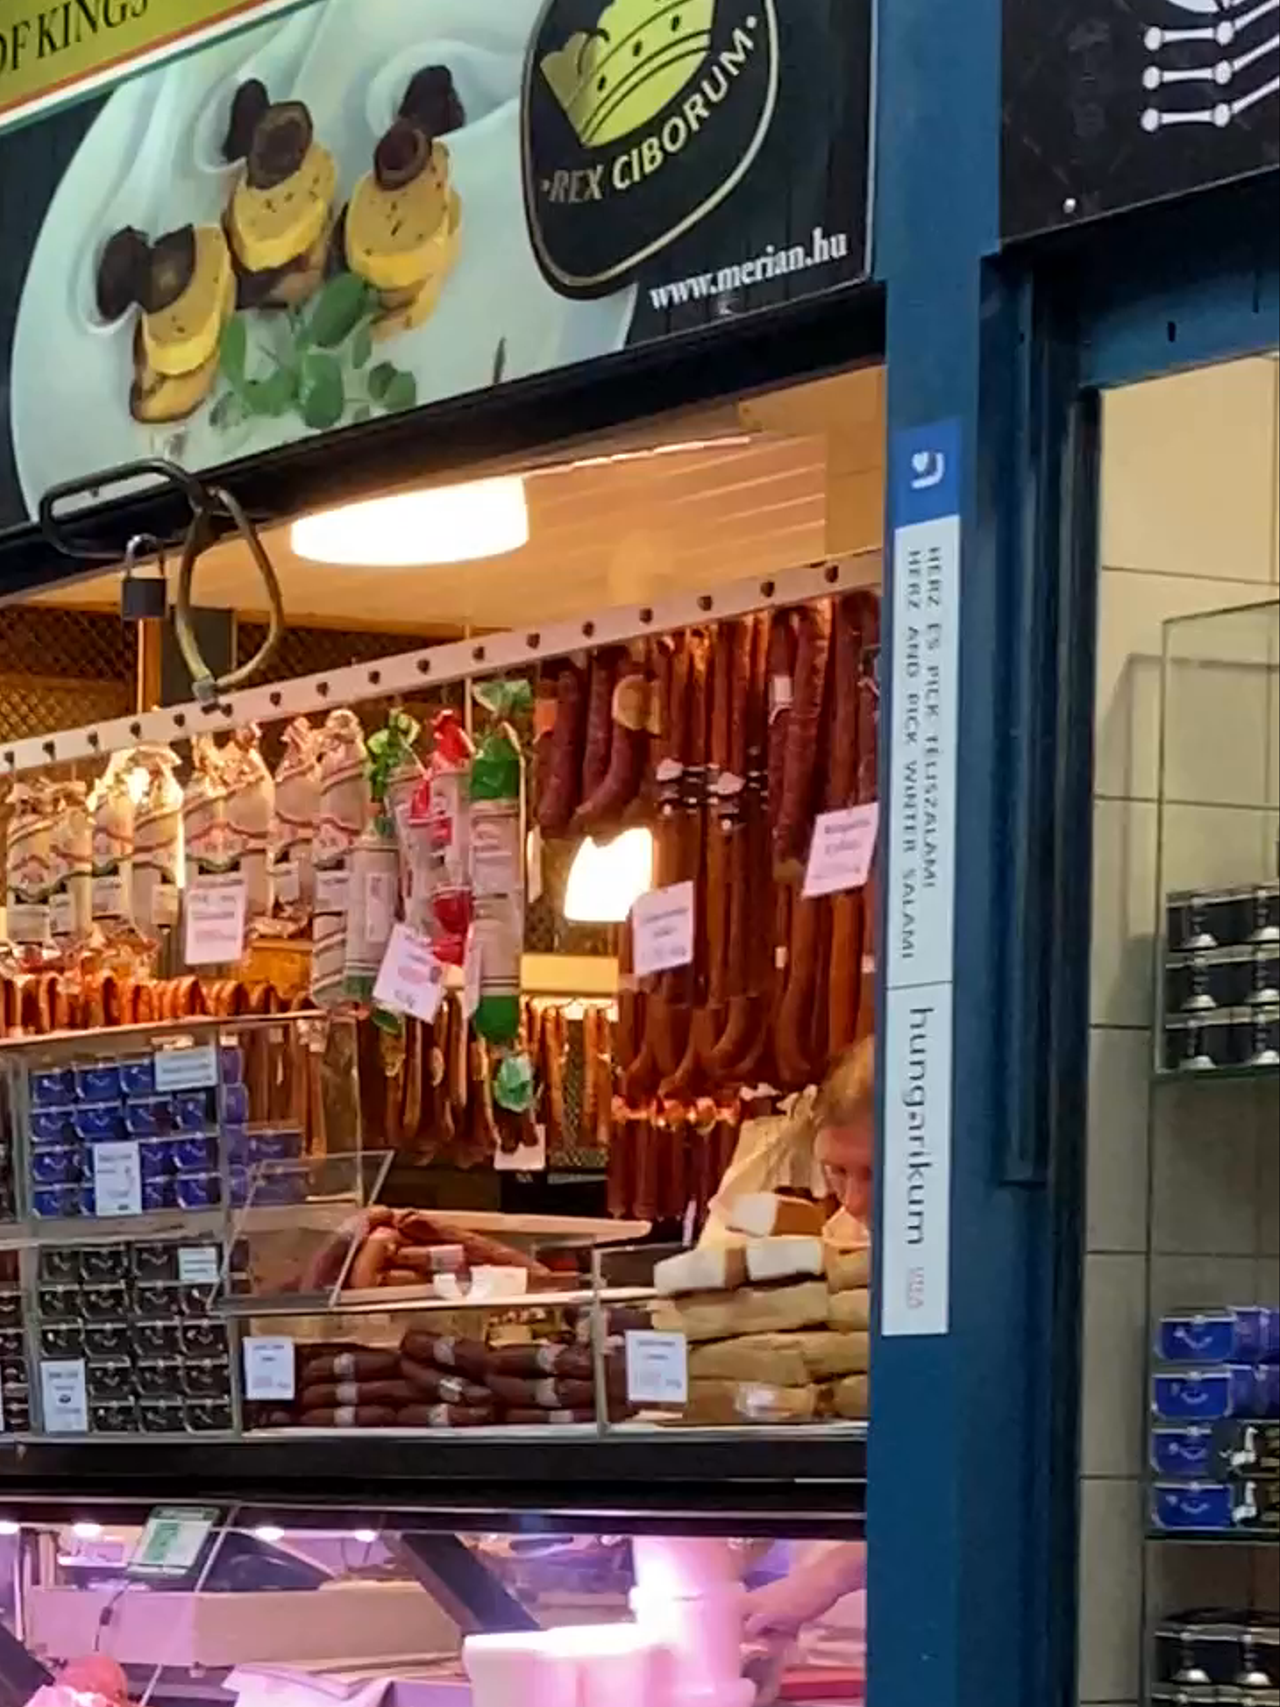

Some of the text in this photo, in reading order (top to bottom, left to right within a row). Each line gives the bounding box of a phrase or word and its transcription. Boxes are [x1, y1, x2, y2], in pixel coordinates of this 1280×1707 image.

[551, 39, 750, 203] REX CIBORUM
[650, 229, 848, 310] www.merian.hu
[926, 546, 942, 606] HERZ
[925, 666, 940, 715] PICK
[900, 549, 922, 959] HERZ AND PICK WINTER SALAMI
[903, 1006, 936, 1245] hungarikum
